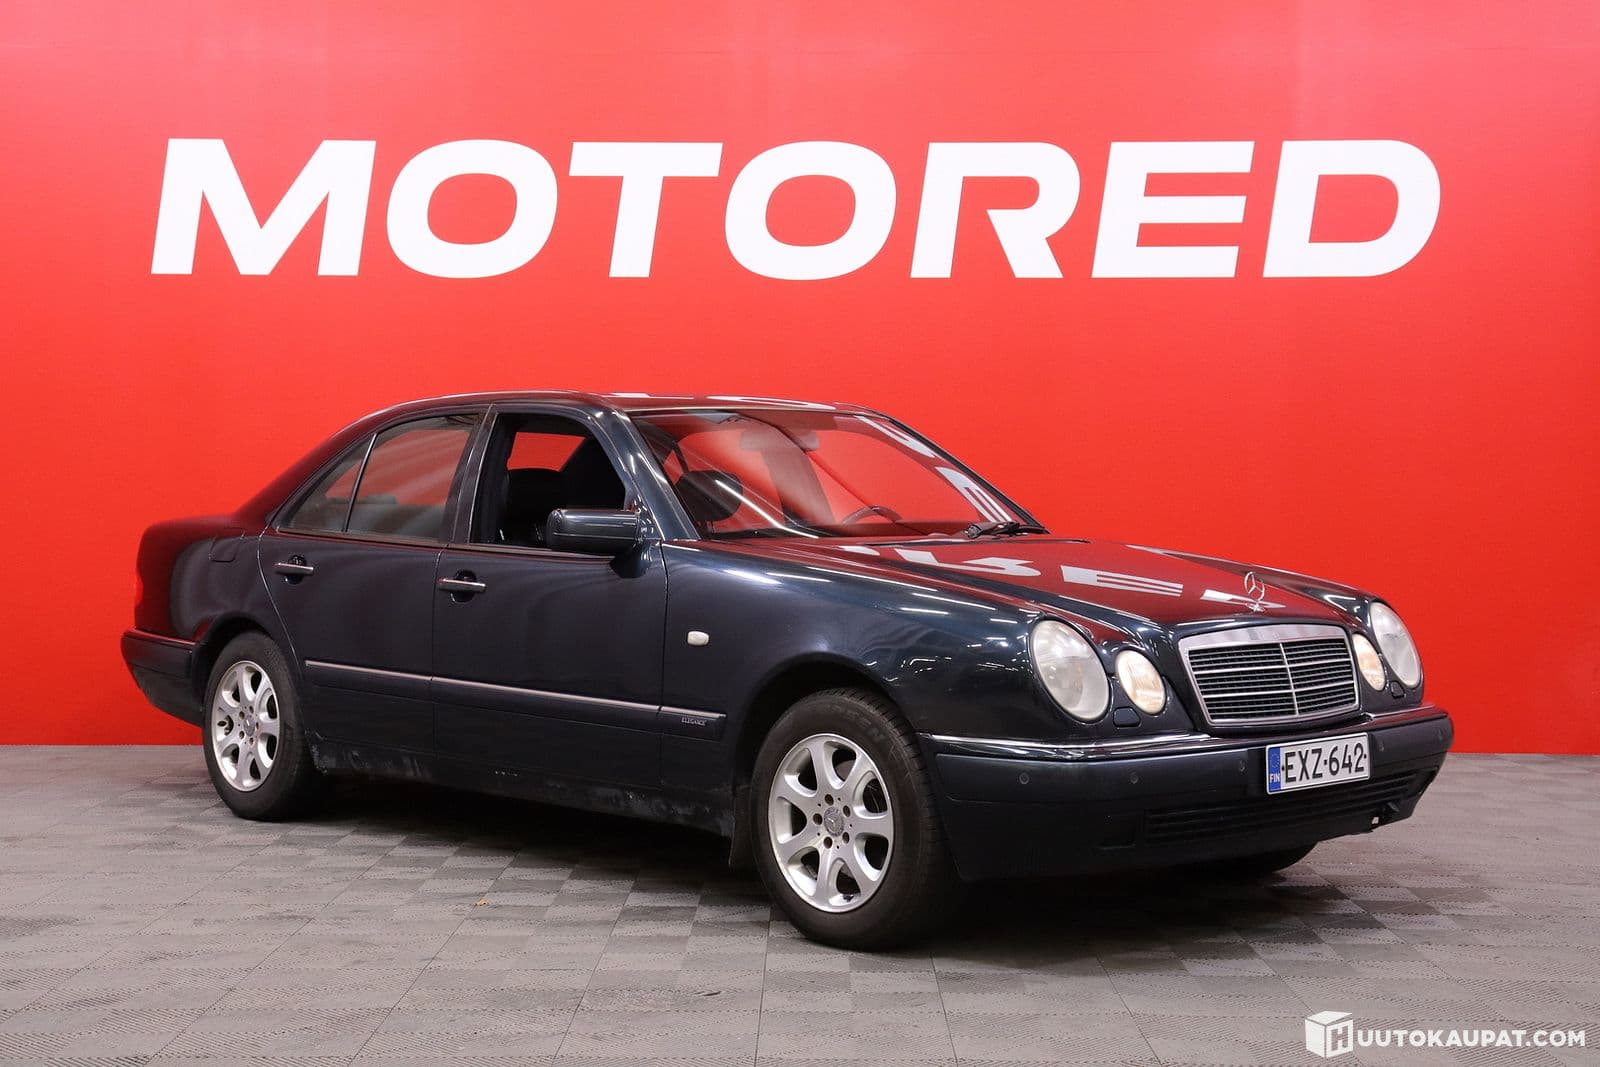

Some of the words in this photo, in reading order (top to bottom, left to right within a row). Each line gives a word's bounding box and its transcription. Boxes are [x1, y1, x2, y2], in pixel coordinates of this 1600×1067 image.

[152, 139, 1441, 280] MOTORED
[1269, 773, 1281, 783] FIN
[1284, 743, 1365, 784] EXZ-642
